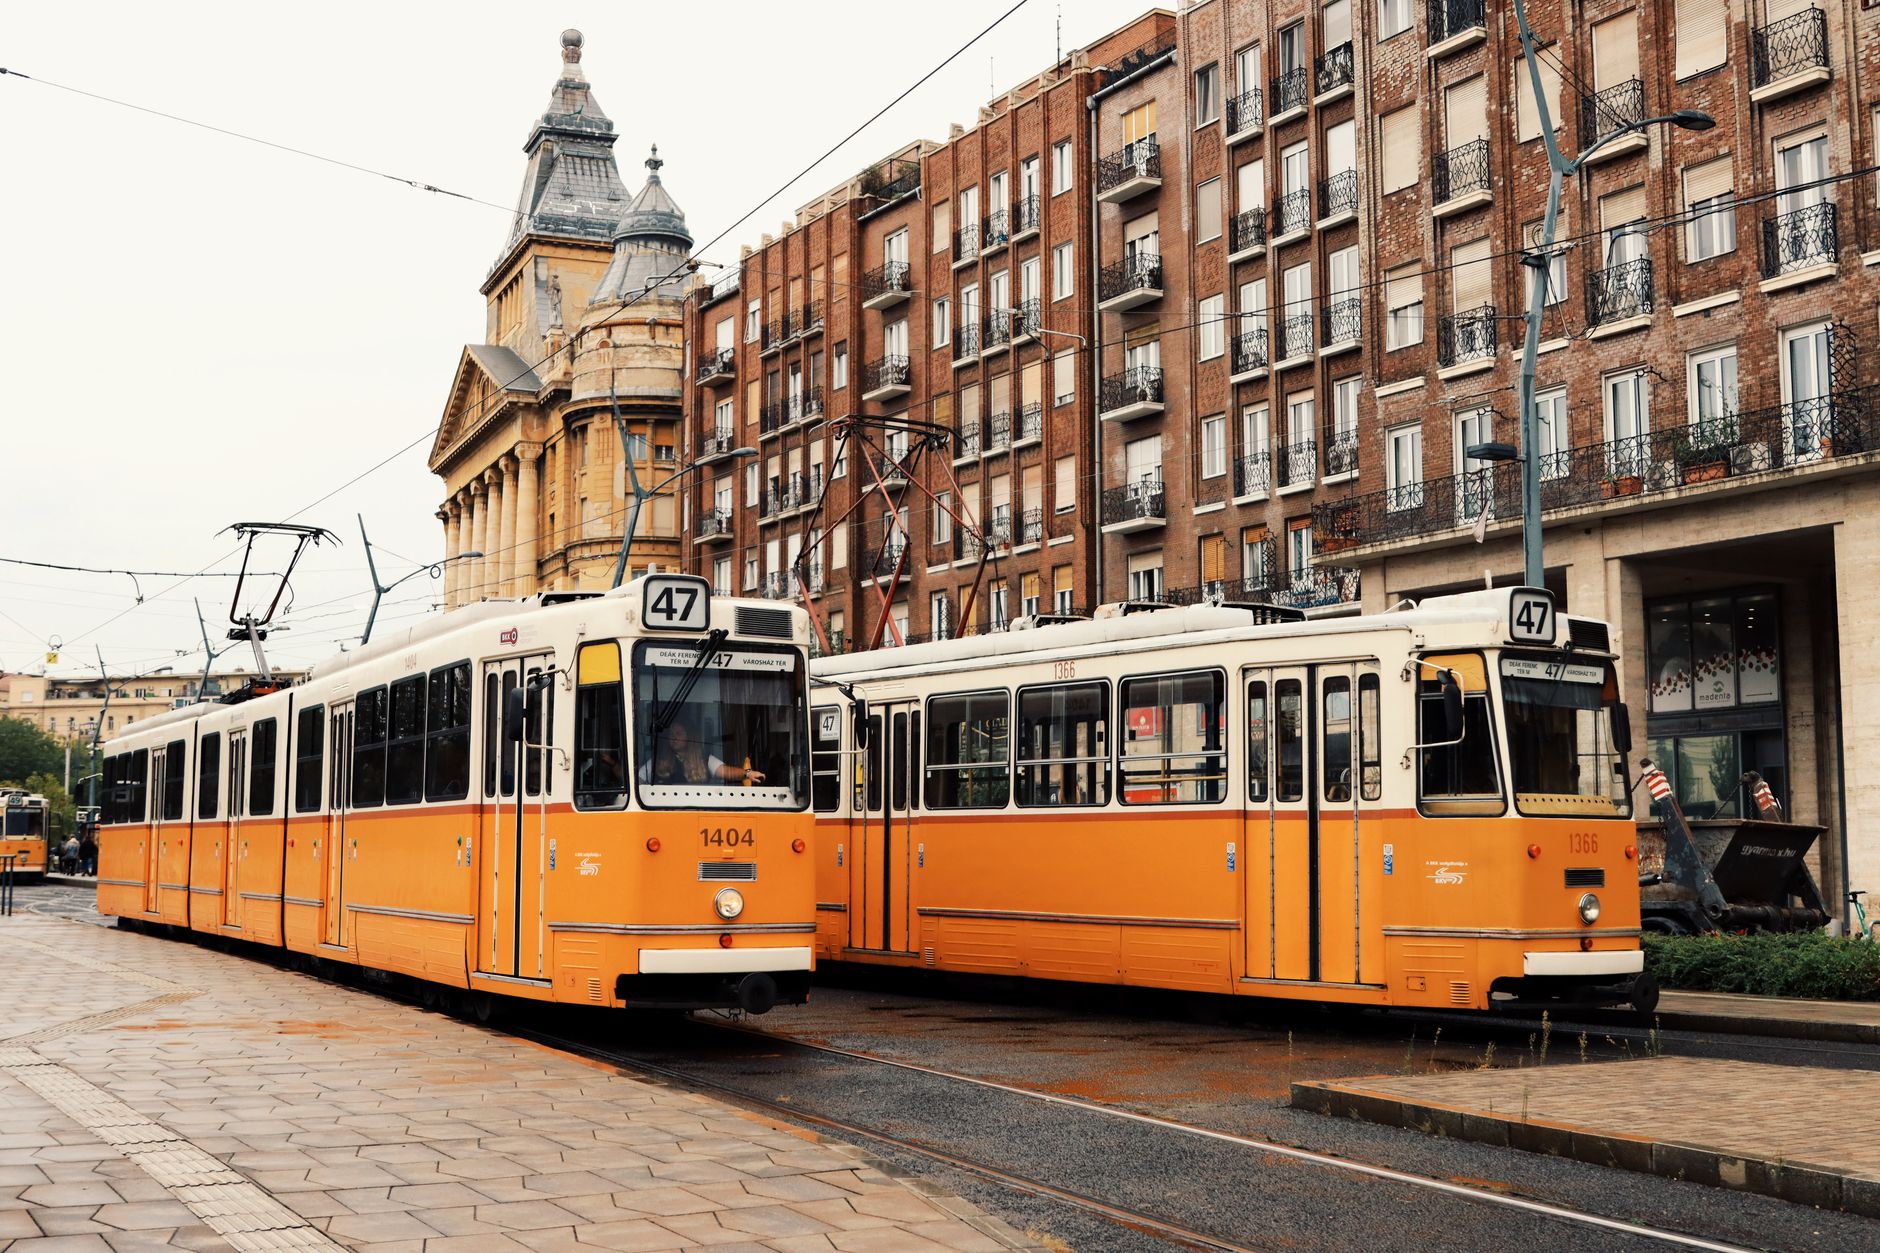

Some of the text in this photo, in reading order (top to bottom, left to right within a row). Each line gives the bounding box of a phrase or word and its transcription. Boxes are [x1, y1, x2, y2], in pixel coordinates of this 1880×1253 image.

[651, 587, 698, 621] 47
[1516, 601, 1548, 634] 47
[659, 650, 677, 658] DEÁK
[711, 653, 734, 668] 47
[742, 657, 774, 666] VÁROSHÁZ
[1054, 660, 1075, 680] 1366
[1545, 663, 1560, 678] 47
[822, 715, 835, 731] 47
[700, 828, 754, 847] 1404
[1569, 833, 1598, 854] 1366
